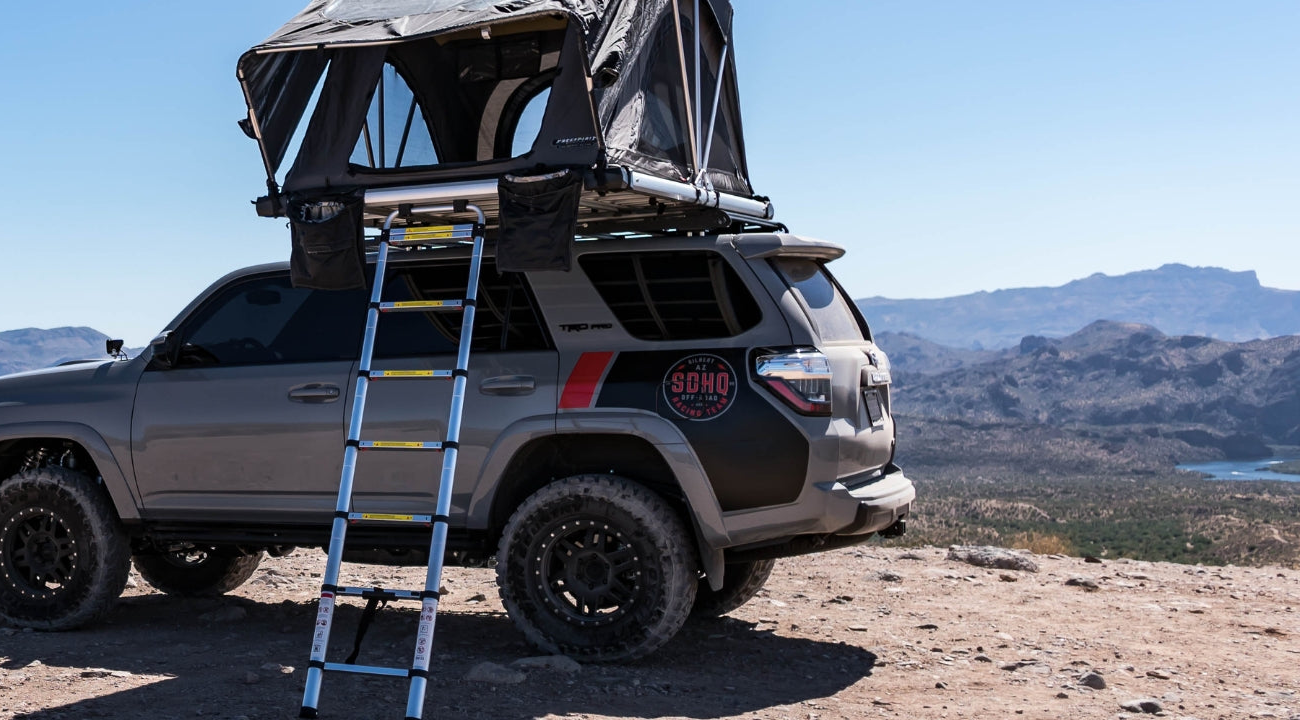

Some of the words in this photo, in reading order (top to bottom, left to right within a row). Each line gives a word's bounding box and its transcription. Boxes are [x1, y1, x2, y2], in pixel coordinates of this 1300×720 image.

[559, 323, 589, 332] TRD
[671, 372, 729, 396] SDHQ
[671, 396, 703, 417] RACING
[706, 396, 729, 416] TEAM
